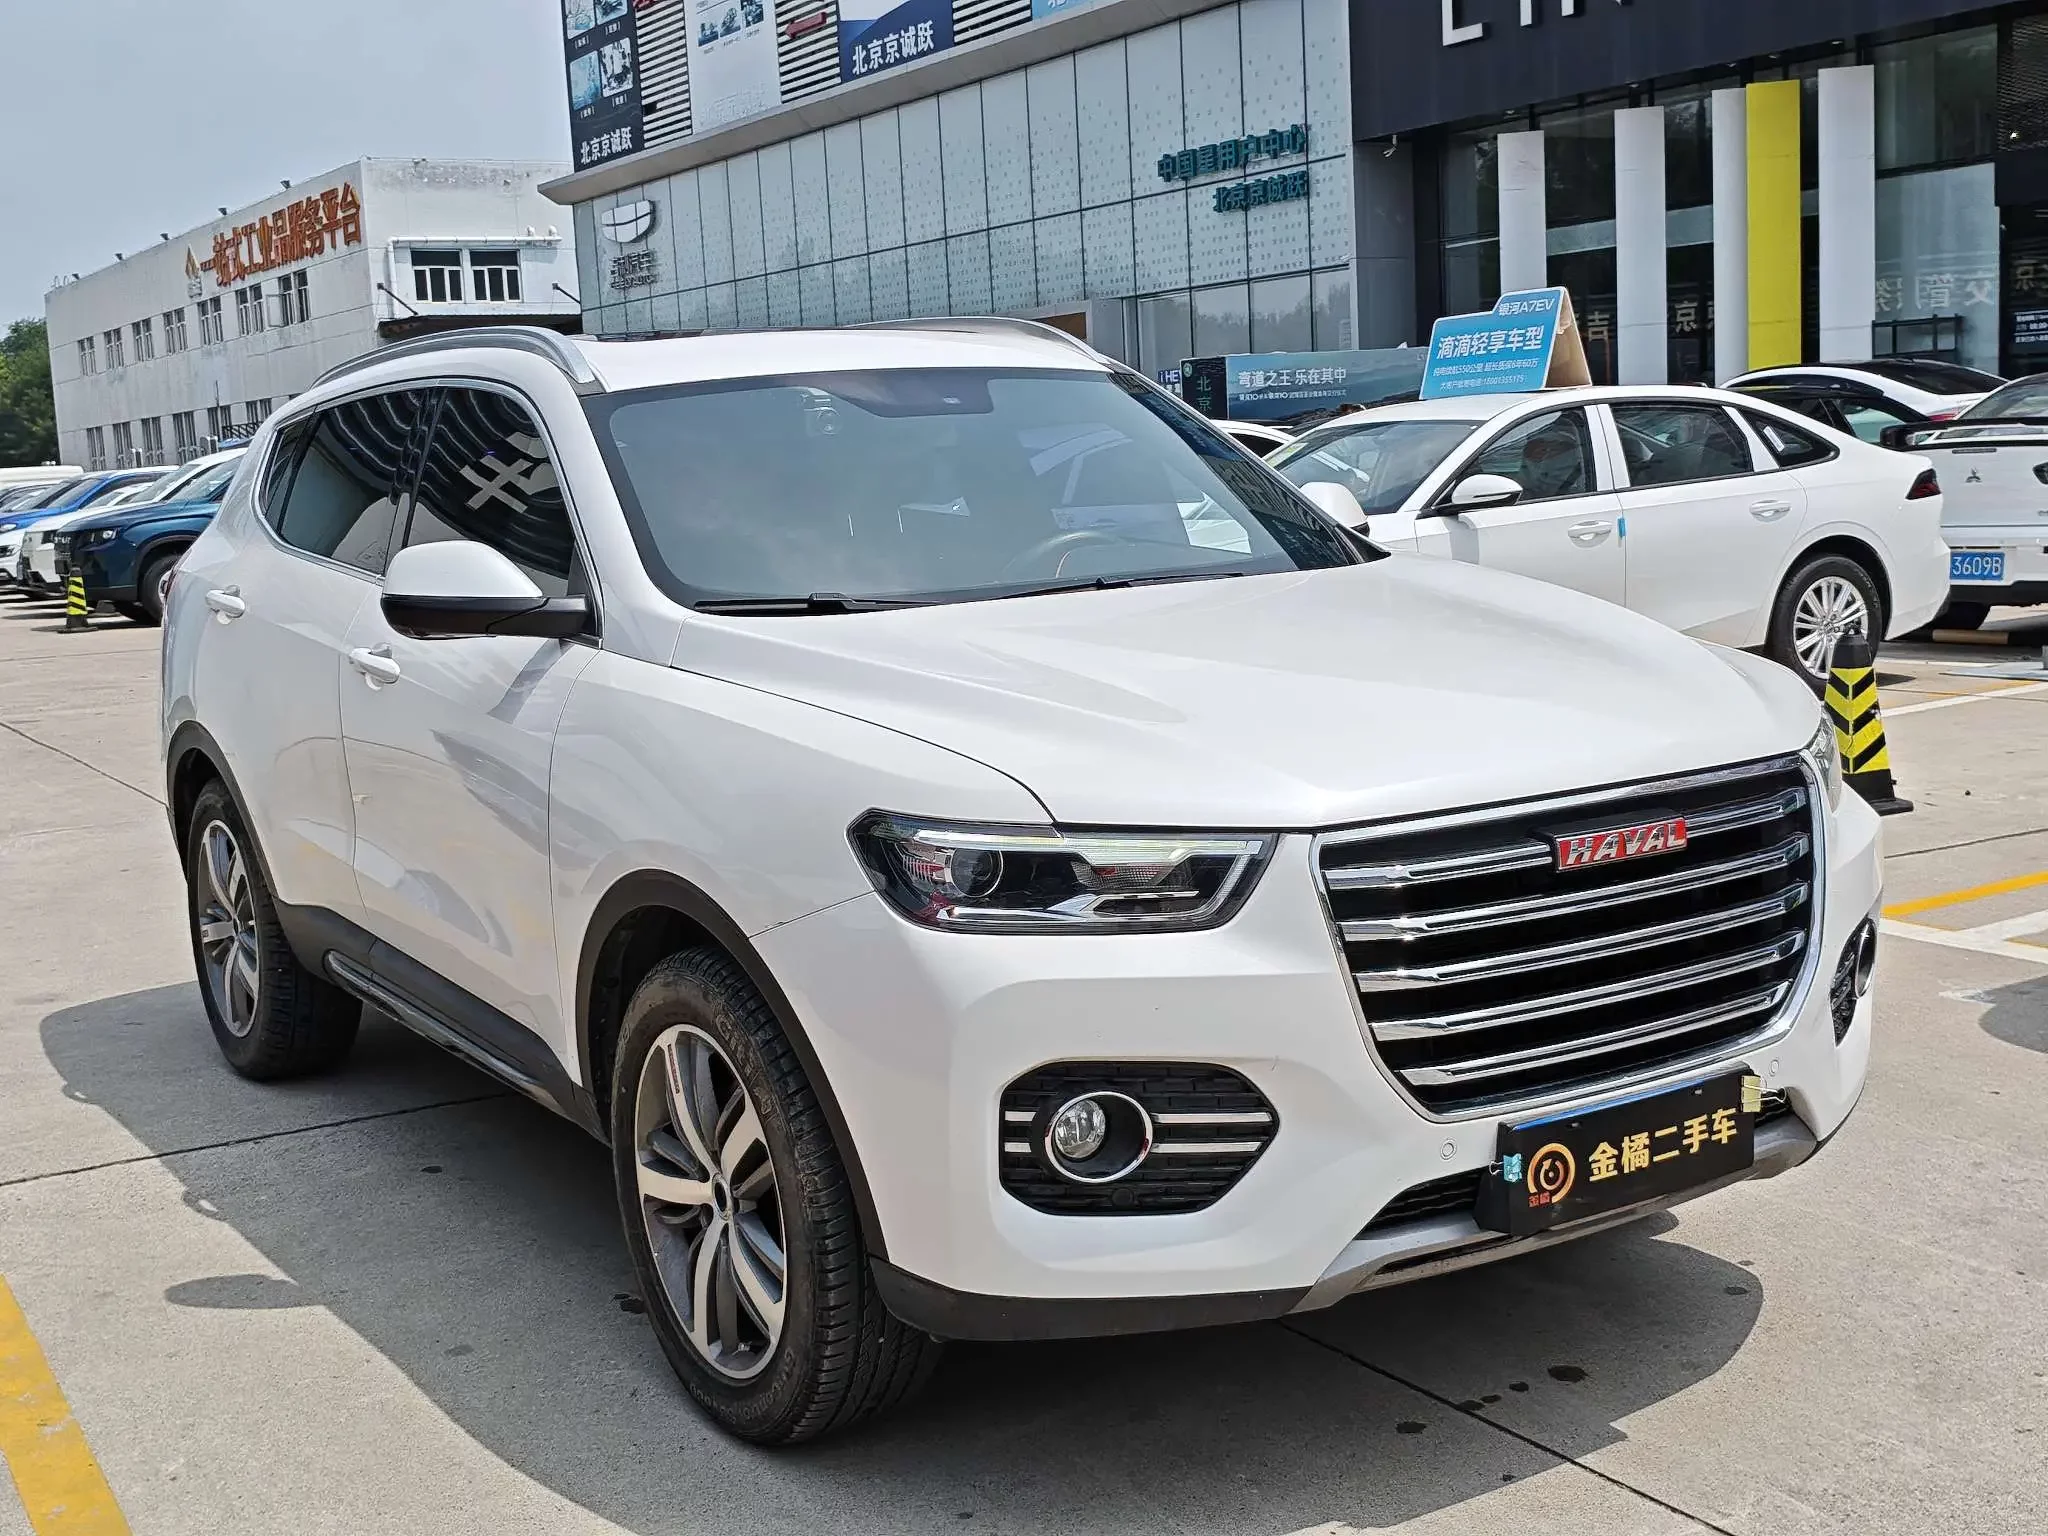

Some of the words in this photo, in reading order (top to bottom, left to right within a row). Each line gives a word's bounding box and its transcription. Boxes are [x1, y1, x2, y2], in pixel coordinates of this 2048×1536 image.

[852, 19, 934, 76] 北京京诚跃
[580, 126, 633, 165] 北京京诚跃
[1157, 124, 1306, 183] 中国星用户中心
[1212, 170, 1308, 213] 北京京诚跃
[1499, 299, 1555, 316] 银河A7EV
[1436, 322, 1545, 360] 滴滴轻享车型
[1238, 370, 1292, 388] 弯道之王
[1294, 367, 1347, 386] 乐在其中
[1566, 823, 1687, 865] HAVAL
[1588, 1106, 1738, 1183] 金橘二手车
